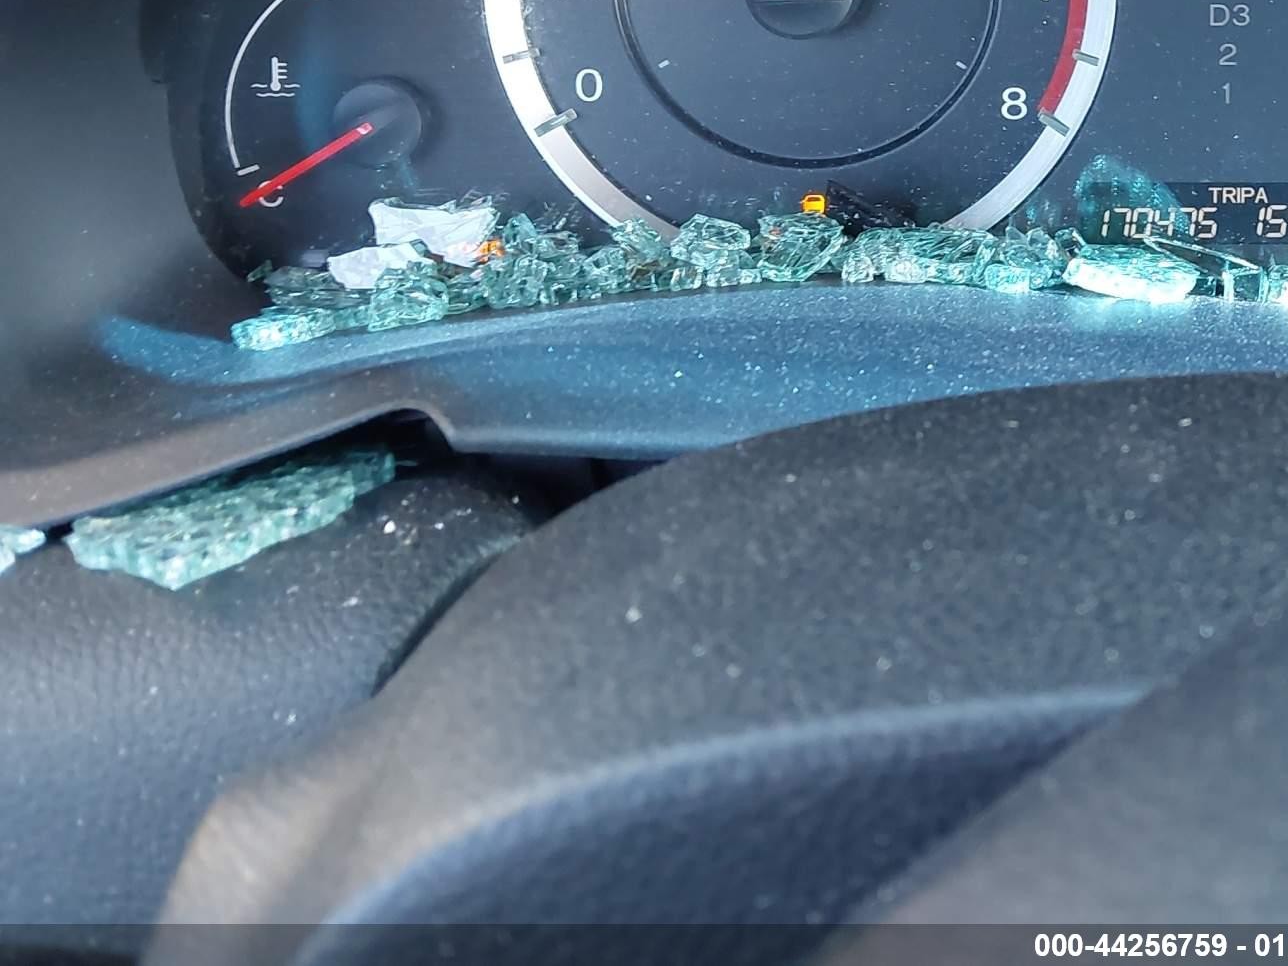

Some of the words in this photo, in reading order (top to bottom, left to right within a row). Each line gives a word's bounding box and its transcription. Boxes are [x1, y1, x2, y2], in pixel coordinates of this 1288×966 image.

[1210, 4, 1249, 26] D3
[1219, 44, 1236, 65] 2
[576, 69, 602, 101] 0
[1222, 83, 1230, 103] 1
[1001, 88, 1027, 119] 8
[1101, 207, 1217, 238] 170475
